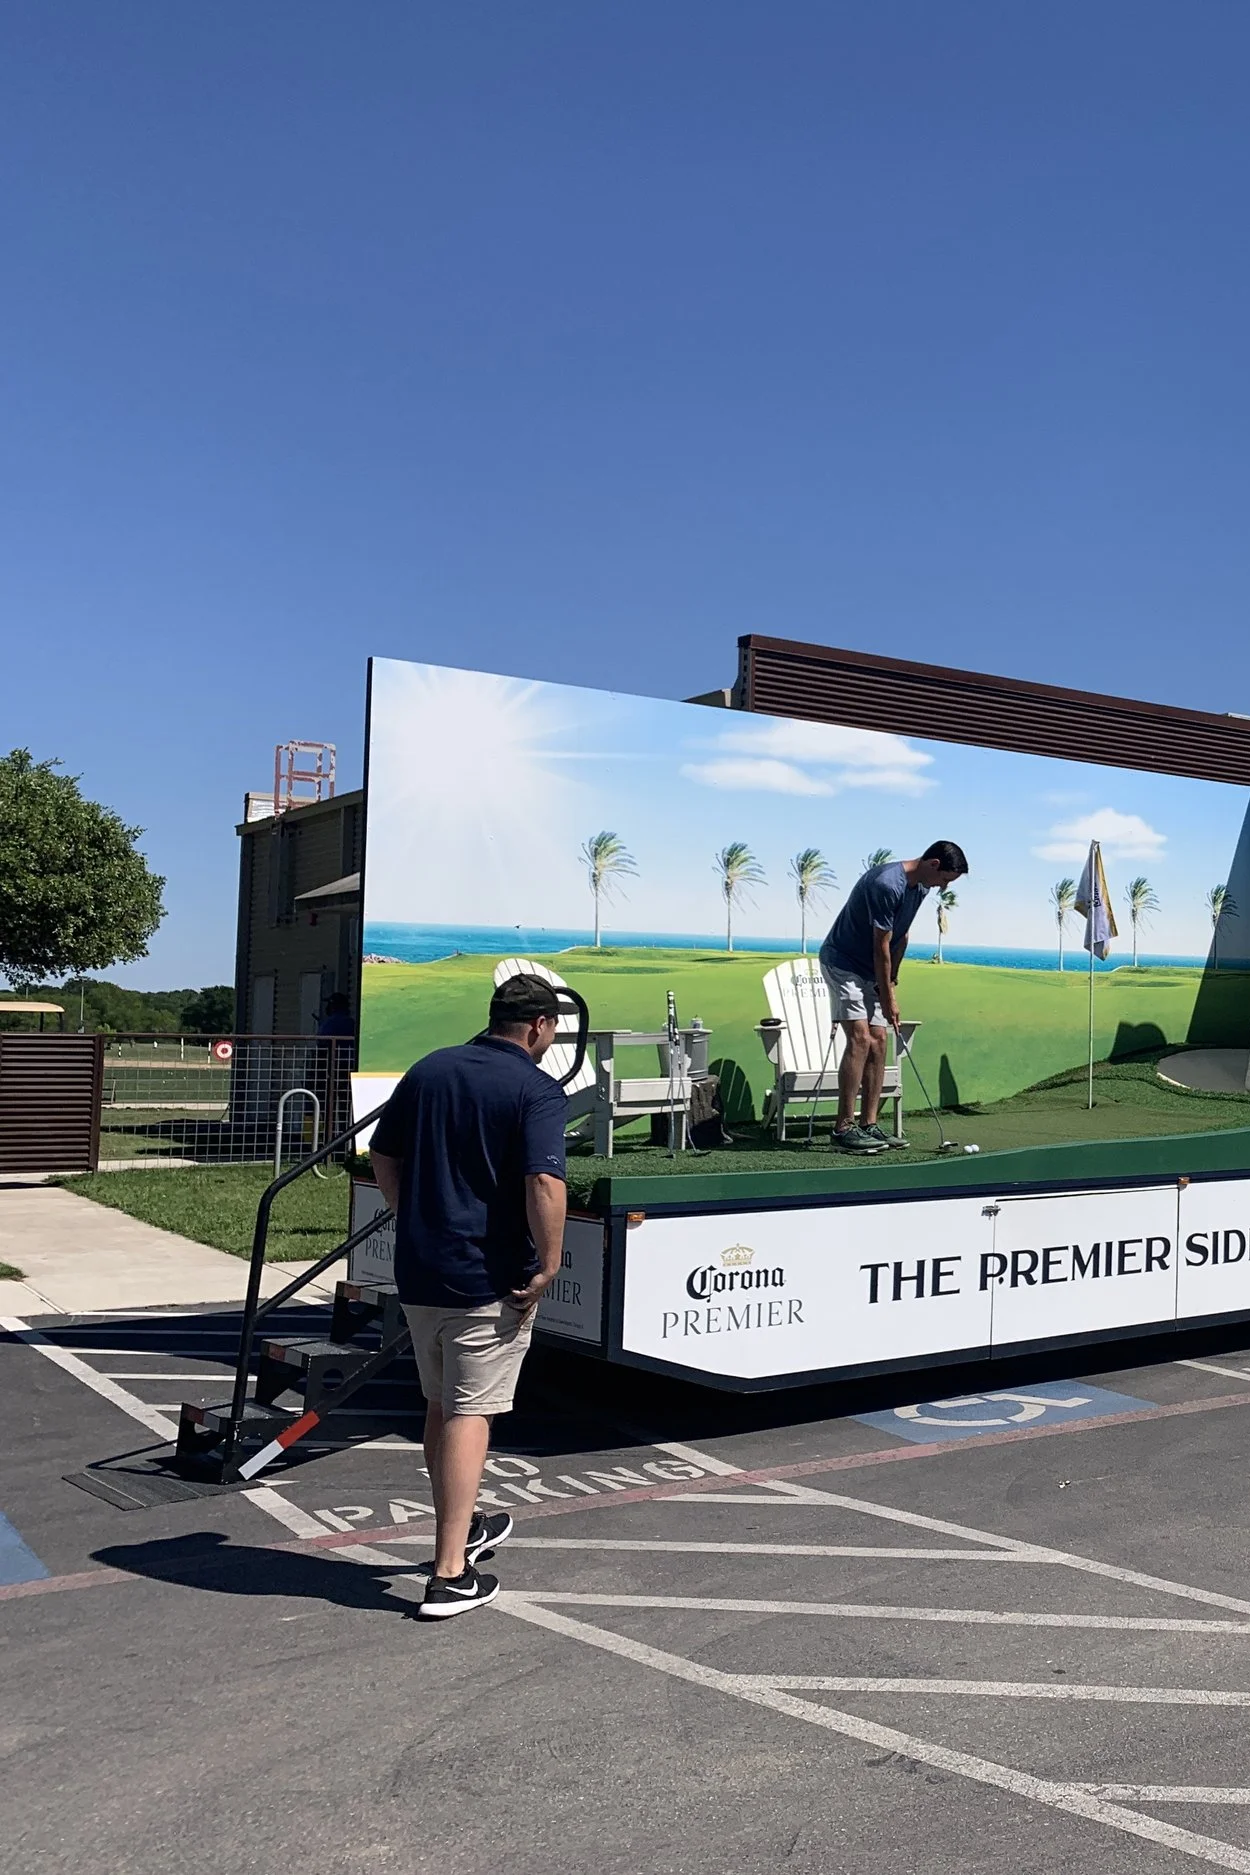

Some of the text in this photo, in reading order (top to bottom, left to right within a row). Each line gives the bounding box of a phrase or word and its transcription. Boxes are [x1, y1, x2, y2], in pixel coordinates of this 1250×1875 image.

[790, 974, 823, 987] Coro
[686, 1263, 787, 1302] Corona
[859, 1255, 962, 1304] THE
[979, 1235, 1171, 1292] PREMIER
[540, 1278, 582, 1306] MIER
[661, 1298, 805, 1339] PREMIER
